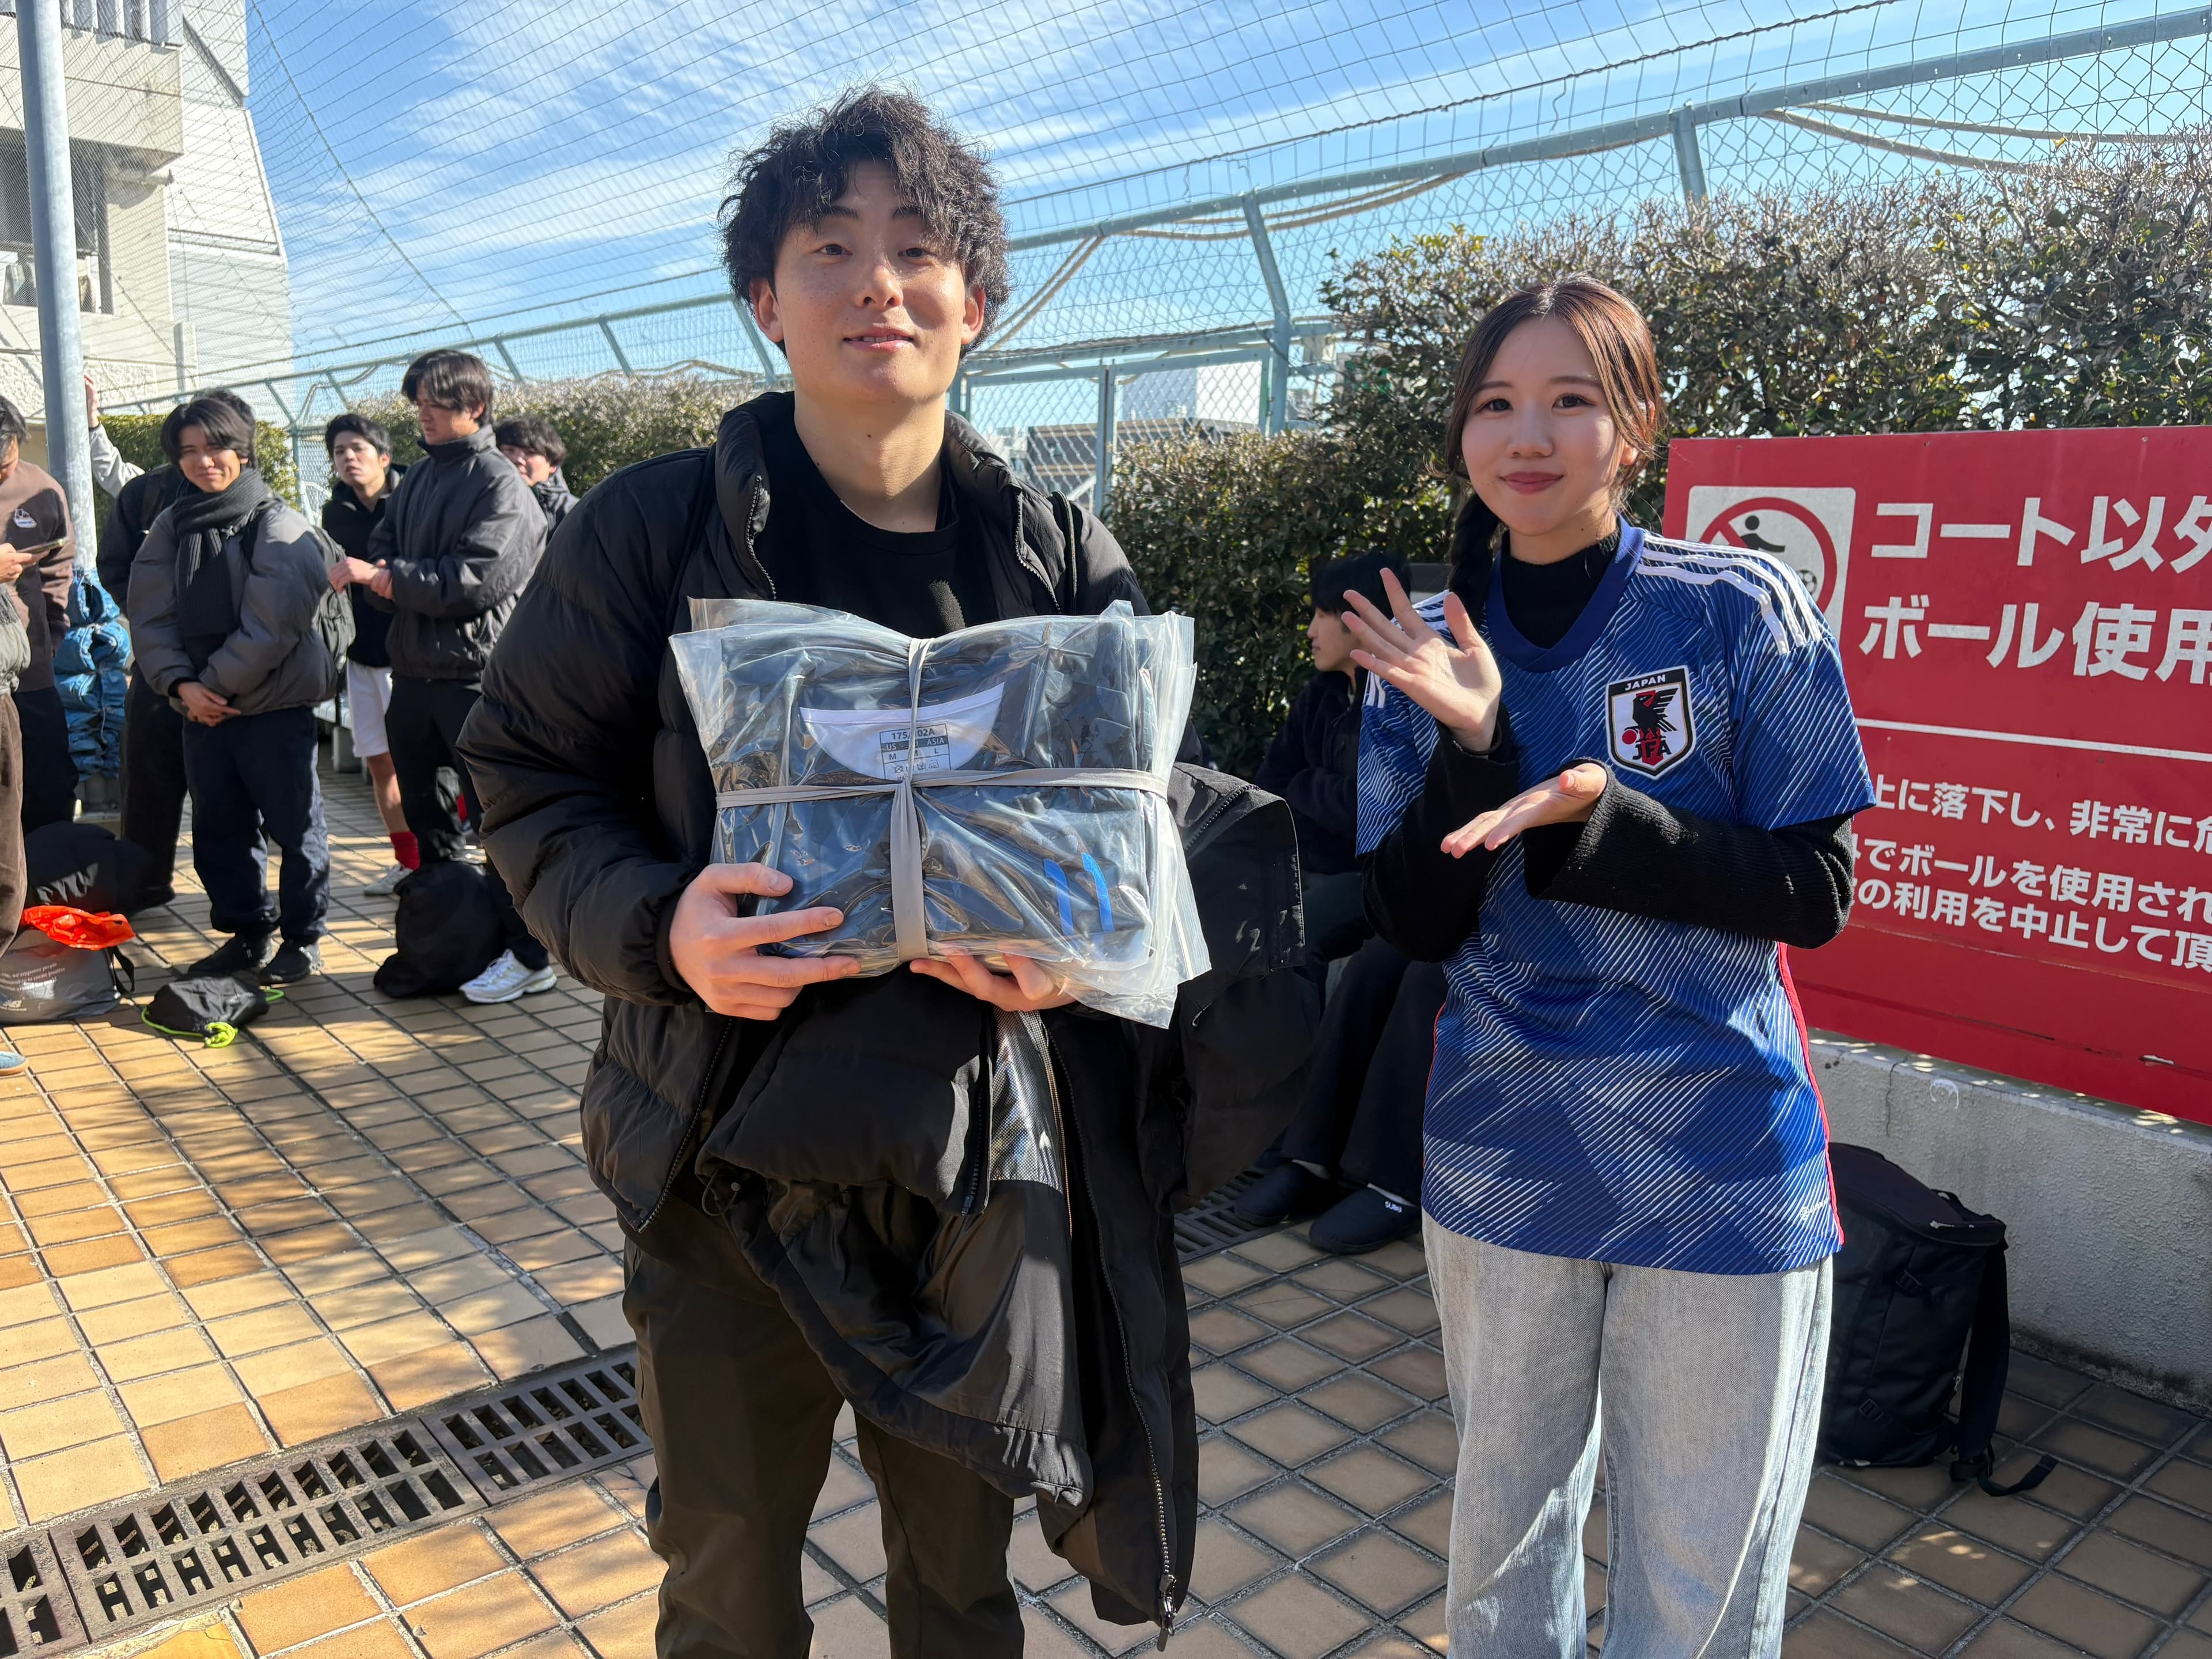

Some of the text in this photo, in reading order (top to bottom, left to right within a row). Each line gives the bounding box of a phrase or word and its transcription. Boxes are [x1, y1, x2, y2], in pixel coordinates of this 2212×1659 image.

[1859, 594, 2212, 685] ボール使用
[1624, 674, 1666, 691] JAPAN
[886, 743, 897, 751] US
[926, 737, 945, 746] ASIA
[1632, 739, 1672, 760] JFA
[1852, 833, 2212, 925] でボールを使用され
[1851, 877, 2212, 973] の利用を中止して頂
